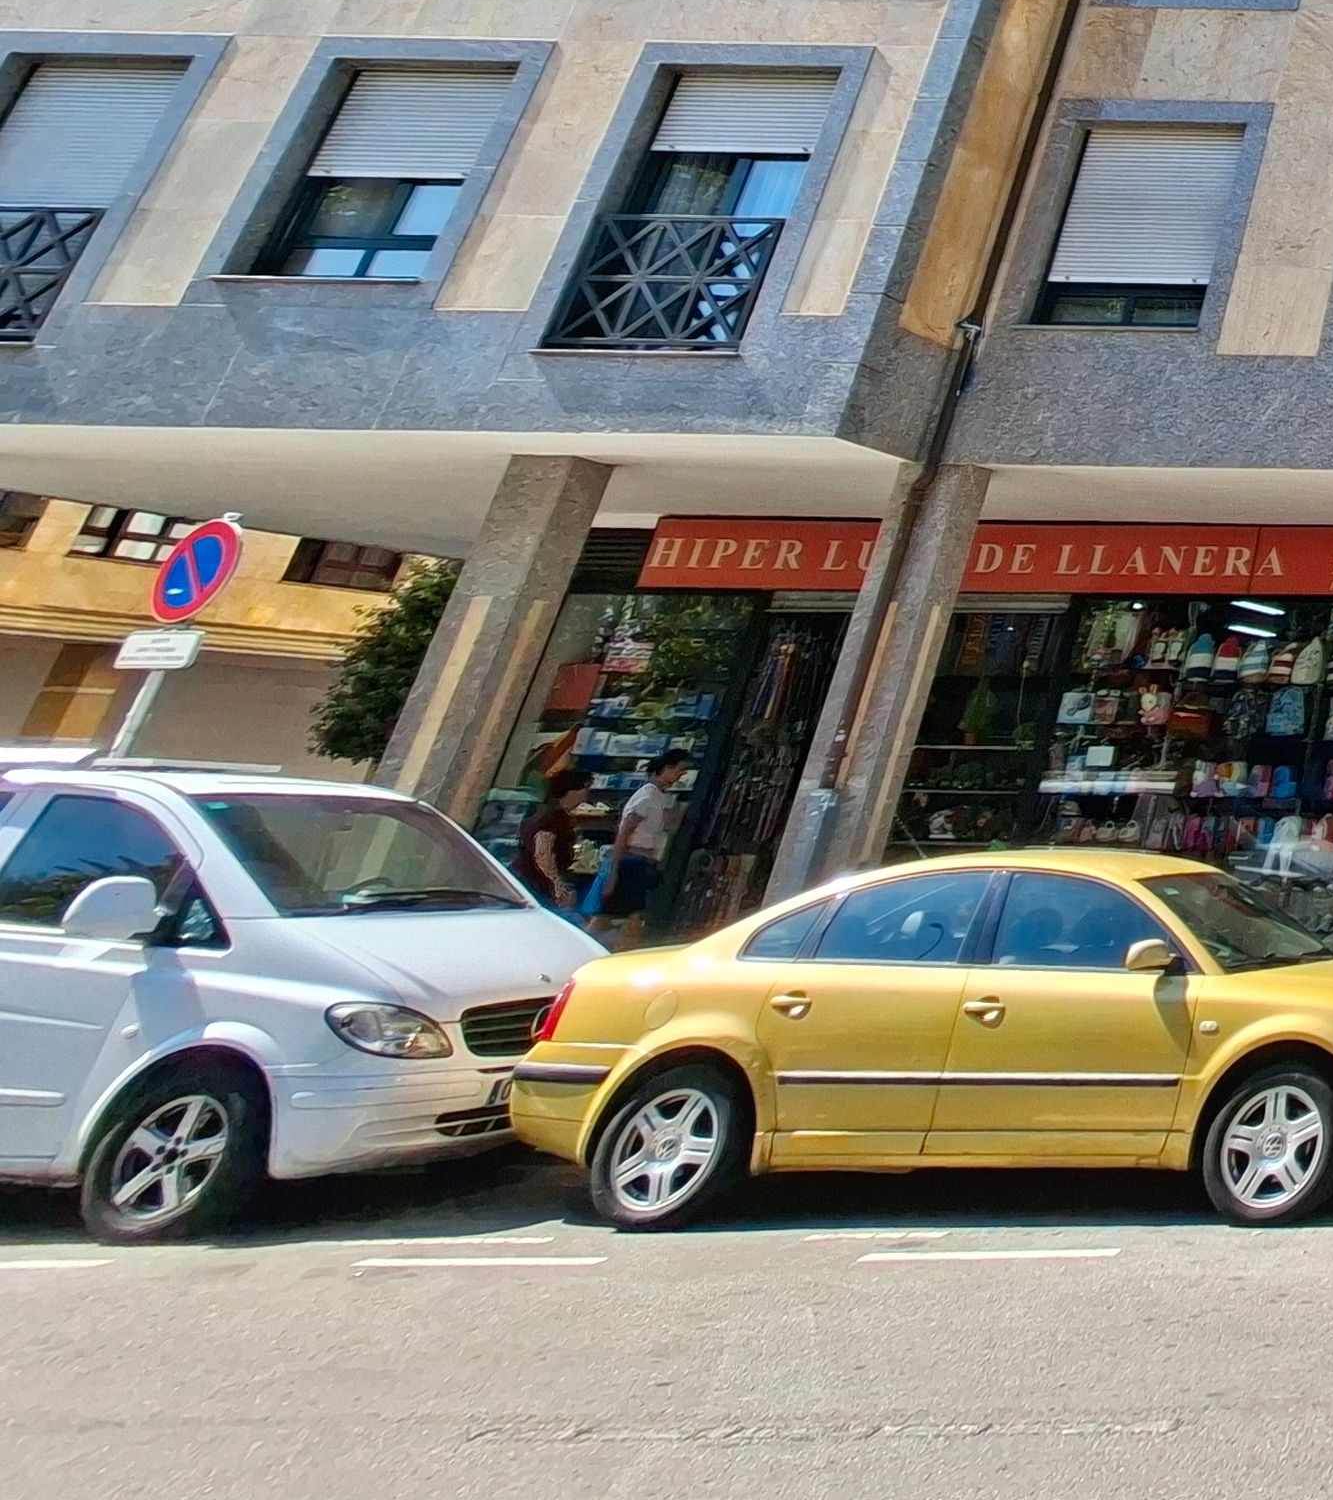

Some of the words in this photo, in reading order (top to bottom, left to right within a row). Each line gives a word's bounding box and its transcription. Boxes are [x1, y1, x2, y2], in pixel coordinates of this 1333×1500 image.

[647, 536, 804, 570] HIPER
[972, 542, 1037, 575] DE
[1053, 543, 1285, 578] LLANERA
